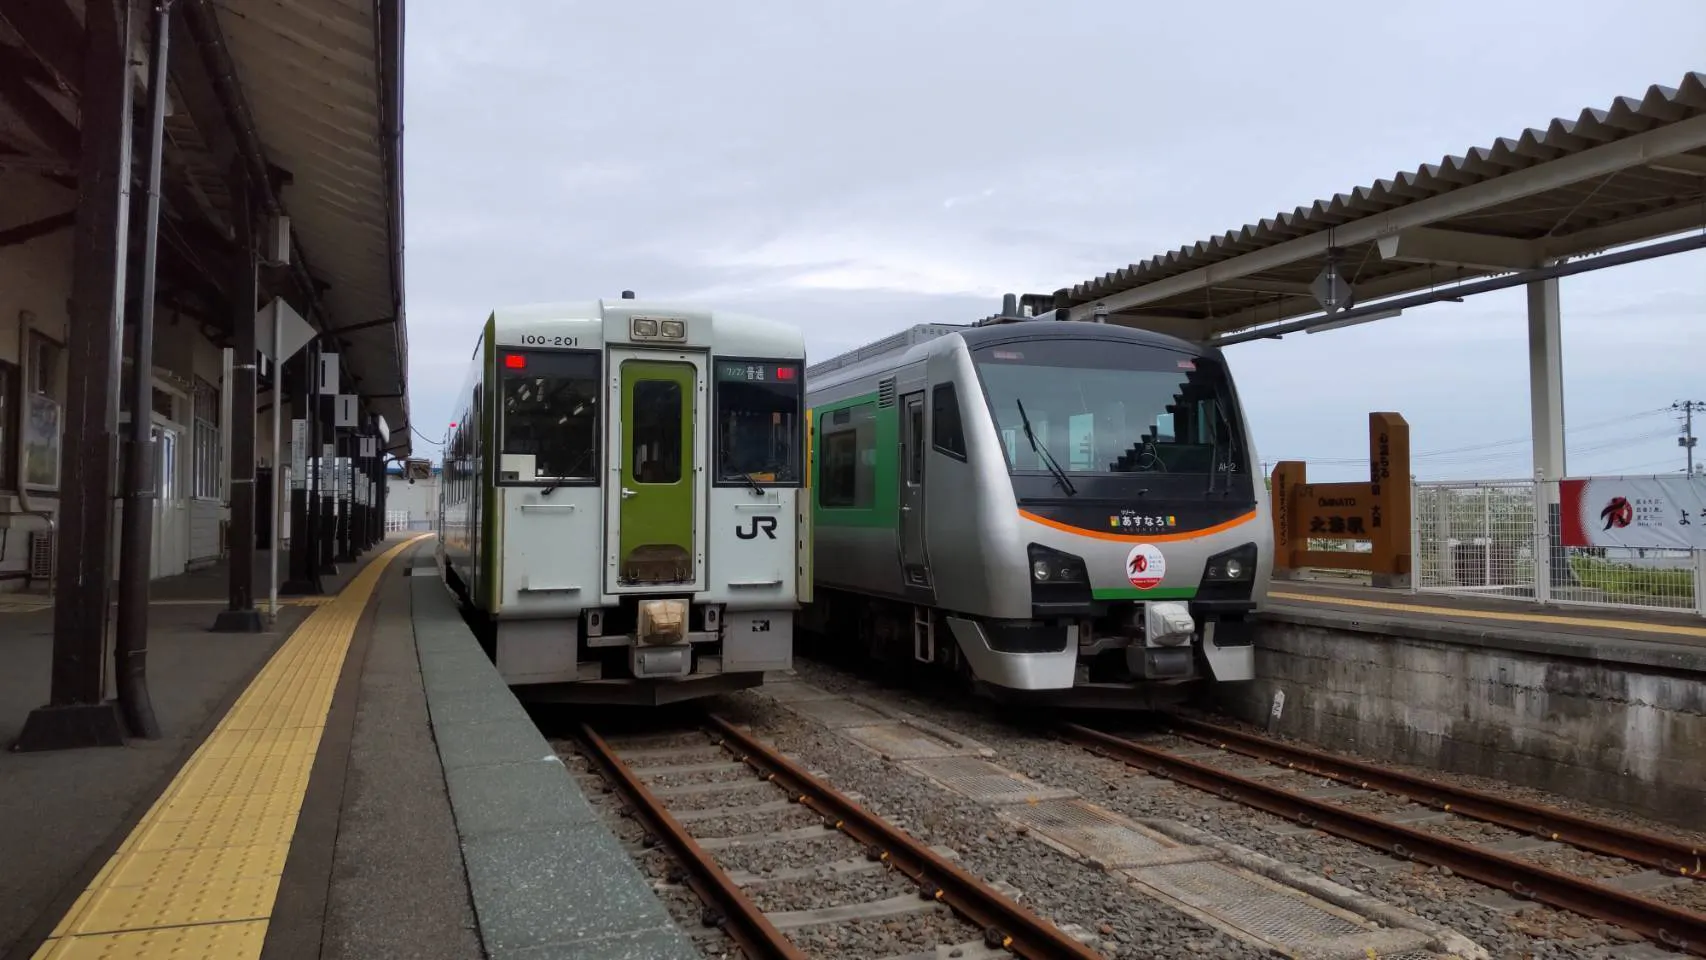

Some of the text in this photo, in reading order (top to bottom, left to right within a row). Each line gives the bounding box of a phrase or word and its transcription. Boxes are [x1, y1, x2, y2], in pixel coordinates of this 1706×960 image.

[520, 334, 579, 348] 100-201
[746, 366, 764, 380] 普通
[735, 516, 777, 540] JR
[1122, 516, 1165, 527] あすなろ
